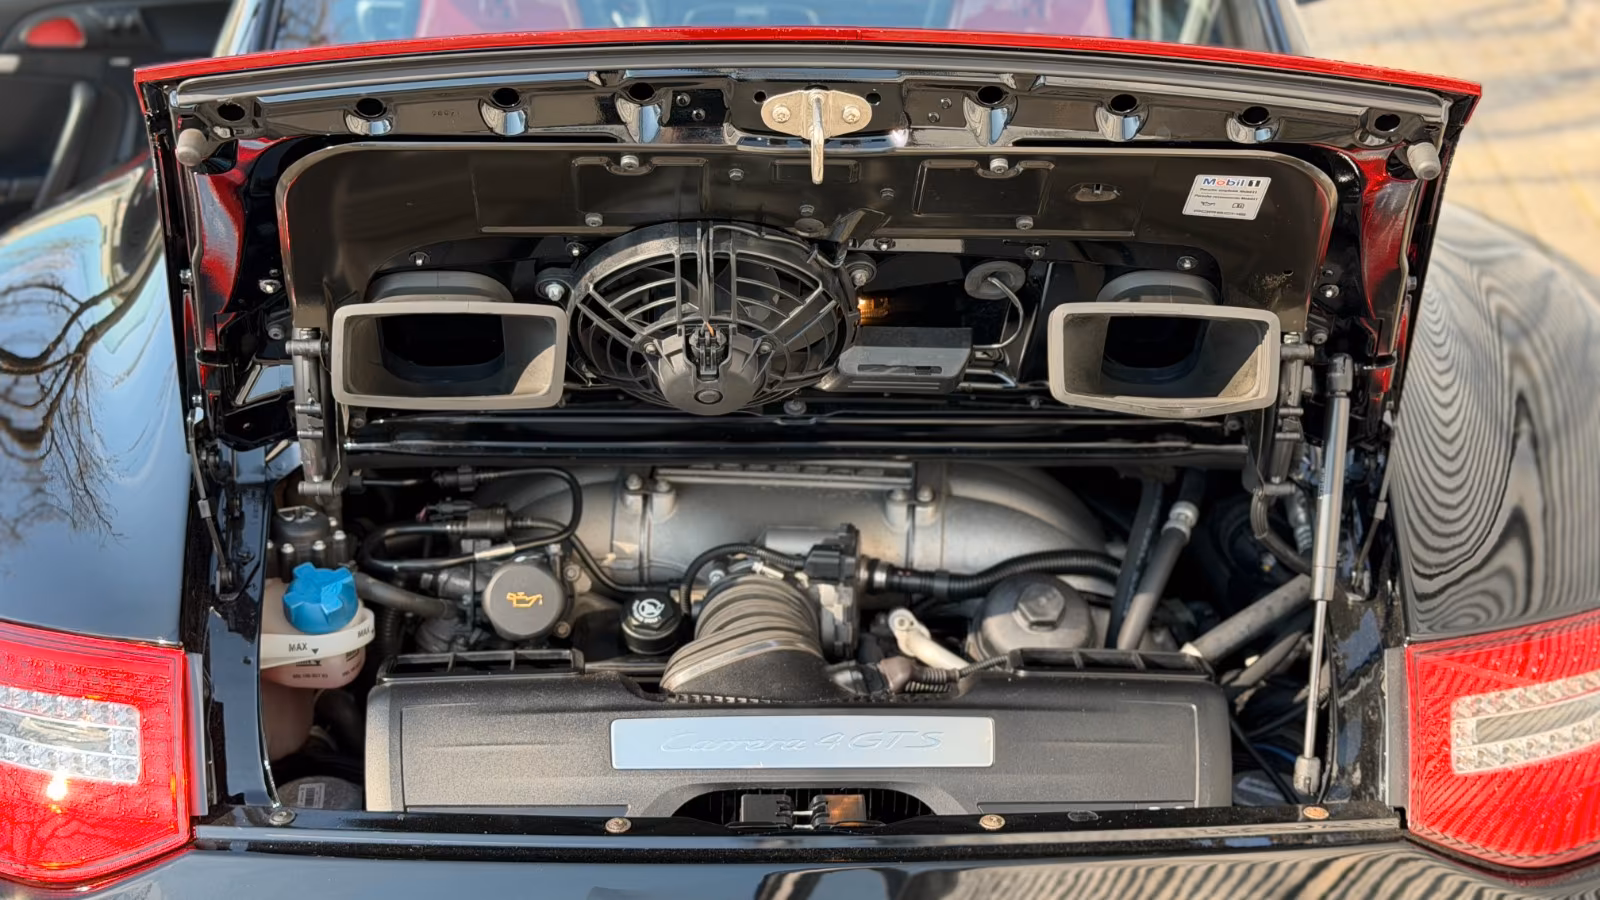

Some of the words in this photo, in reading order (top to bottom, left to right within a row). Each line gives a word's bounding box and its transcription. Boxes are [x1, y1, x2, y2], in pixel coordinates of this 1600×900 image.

[1203, 178, 1245, 186] Mobil
[357, 627, 370, 638] MAX
[288, 643, 308, 652] MAX
[660, 731, 807, 752] Carrera
